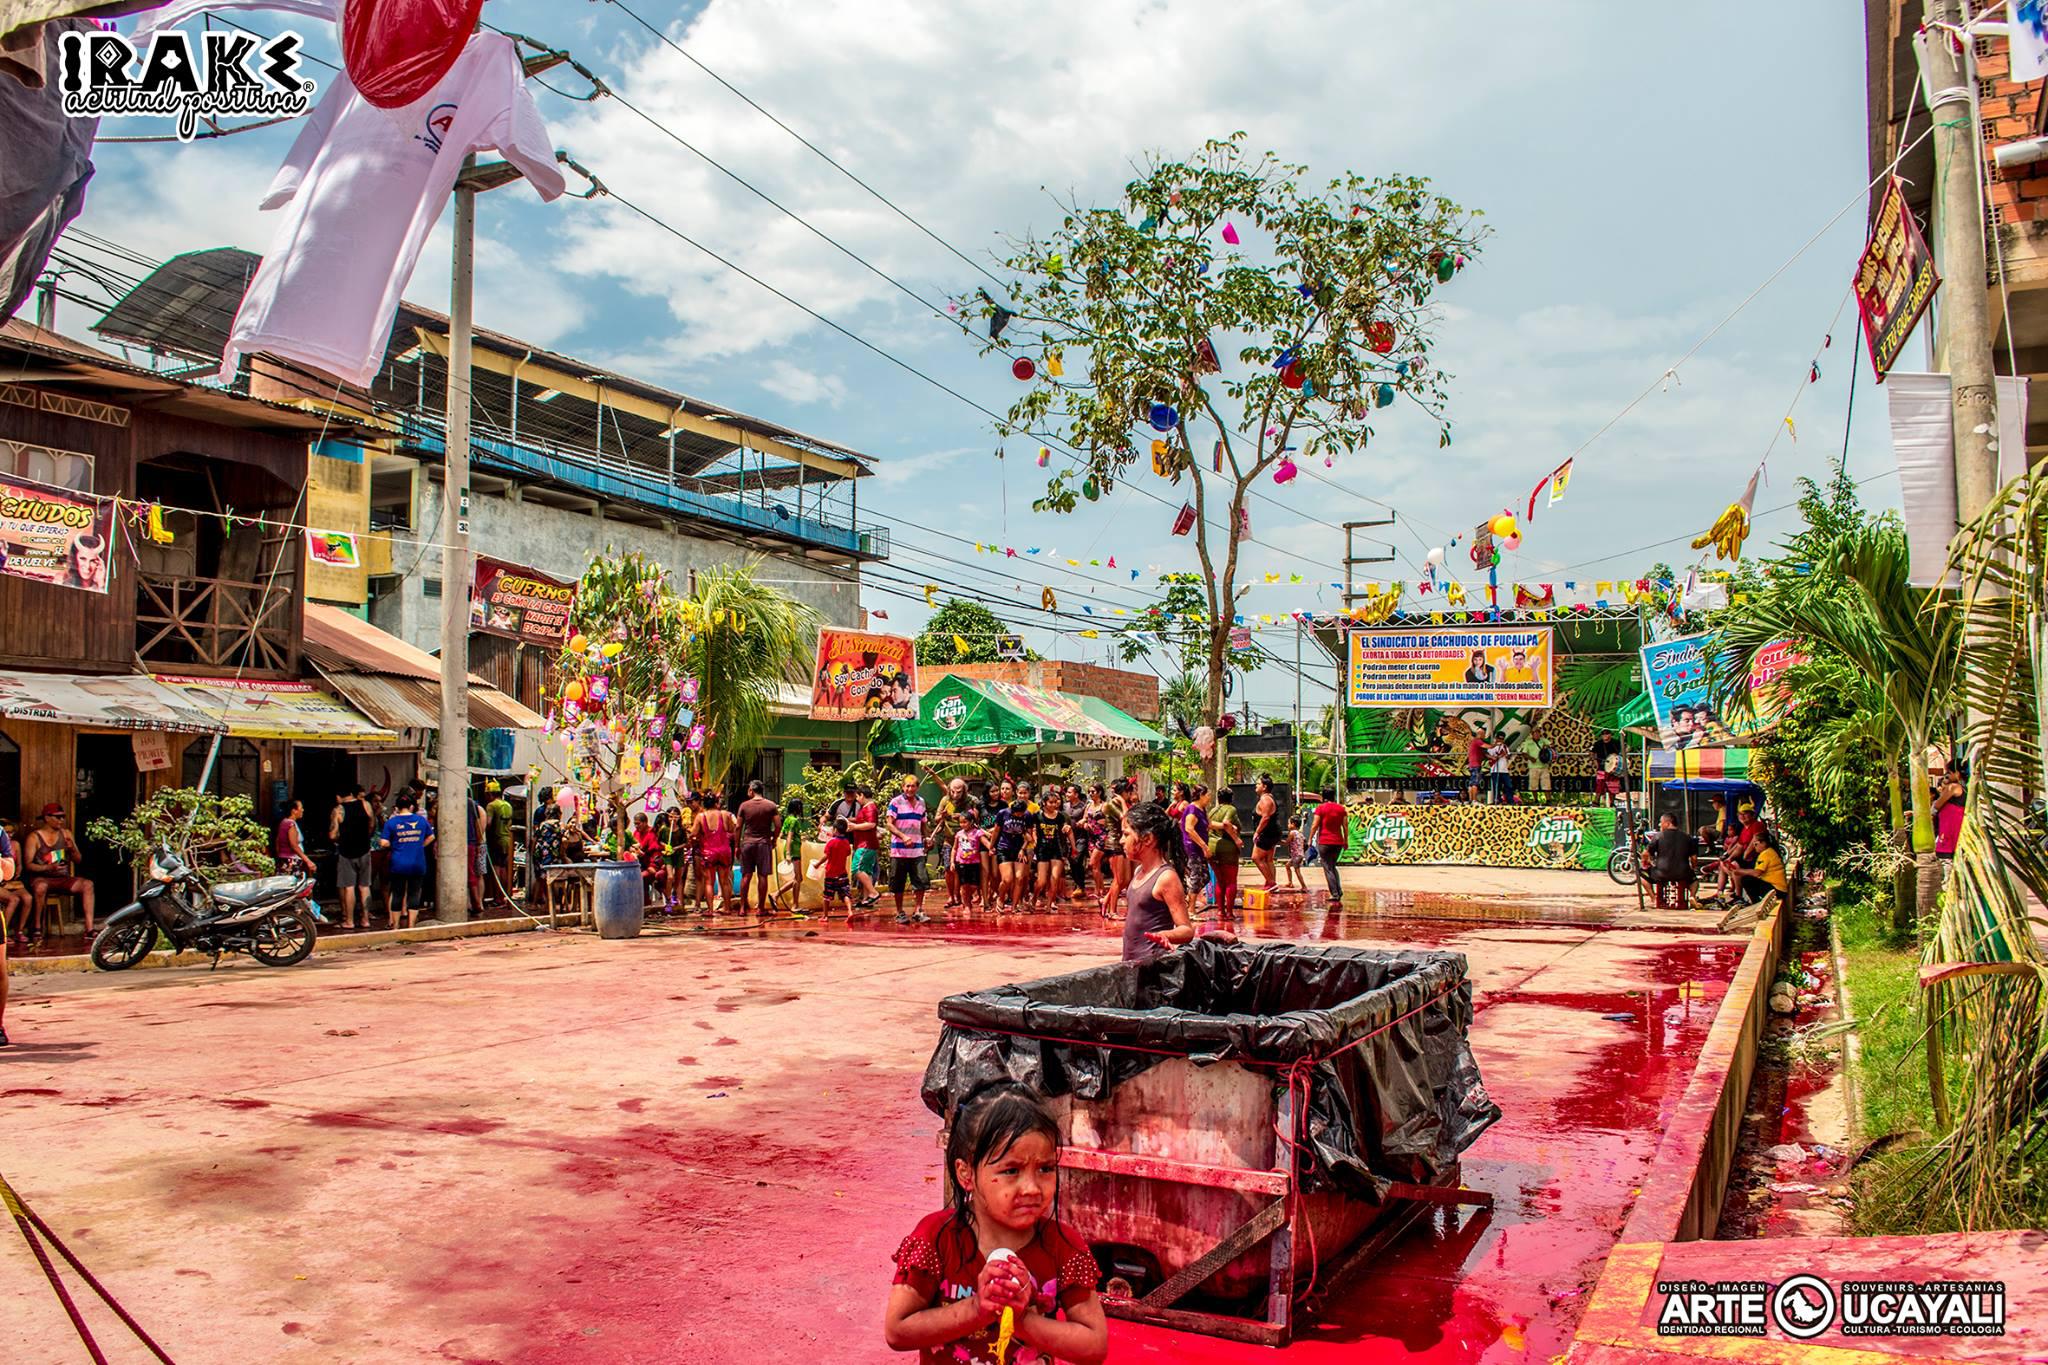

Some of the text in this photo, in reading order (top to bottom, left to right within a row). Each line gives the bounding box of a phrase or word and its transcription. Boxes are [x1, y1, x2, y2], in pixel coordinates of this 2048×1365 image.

[0, 497, 92, 528] CHUDOS
[20, 523, 35, 534] QUE
[9, 557, 57, 569] DEVUELVE
[499, 575, 572, 602] CUERNO
[527, 600, 542, 611] LA
[524, 610, 554, 625] NADIE
[1361, 634, 1539, 648] EL SINDICATO DE CACHUDOS DE PUCALLPA
[1362, 651, 1384, 659] EXORTA
[1390, 651, 1410, 659] TODAS
[1411, 651, 1422, 659] LAS
[1362, 663, 1387, 671] Podrán
[1387, 663, 1408, 671] meter
[834, 674, 848, 686] Soy
[1362, 672, 1387, 680] Podrán
[1416, 673, 1431, 681] pata
[1362, 682, 1376, 690] Pero
[1394, 682, 1412, 690] deben
[1494, 682, 1516, 690] fondos
[939, 698, 961, 708] San
[933, 704, 967, 720] Juan
[1375, 813, 1408, 828] San
[1541, 817, 1575, 831] San
[1363, 825, 1416, 845] Juan
[1526, 829, 1583, 847] Juan
